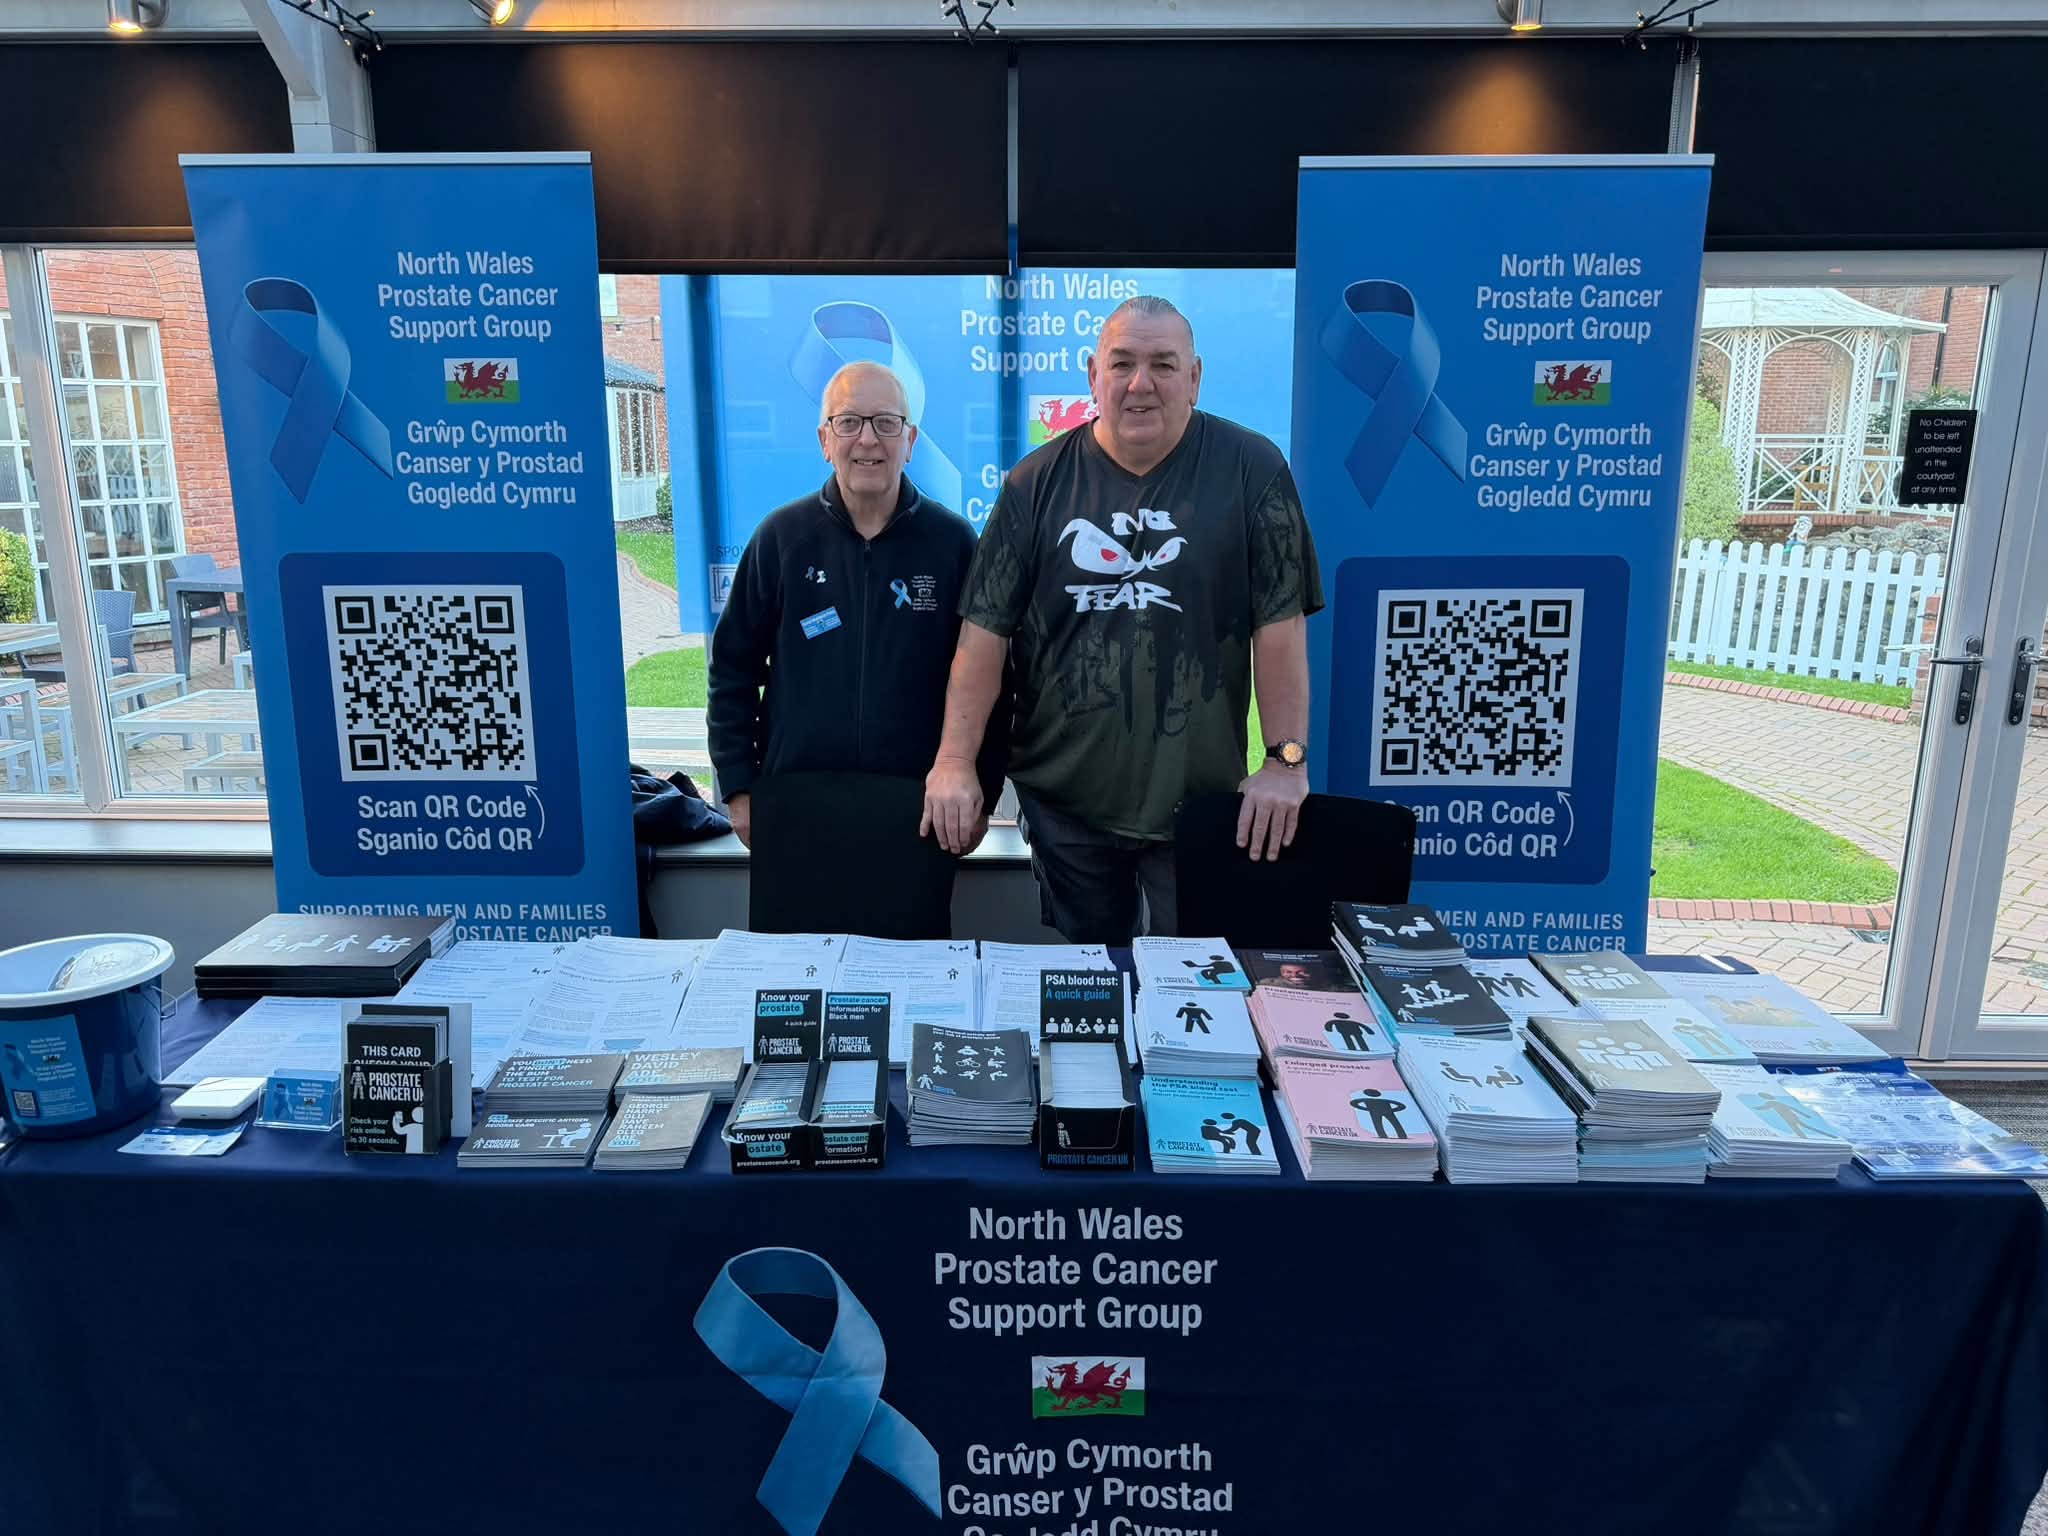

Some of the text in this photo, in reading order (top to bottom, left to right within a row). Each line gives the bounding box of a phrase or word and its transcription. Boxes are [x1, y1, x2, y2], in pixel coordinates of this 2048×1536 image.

[397, 251, 534, 275] North Wales
[1500, 252, 1642, 277] North Wales
[985, 272, 1139, 300] North Wales
[378, 283, 558, 308] Prostate Cancer
[1476, 284, 1663, 309] Prostate Cancer
[389, 315, 552, 343] Support Group
[961, 309, 1066, 336] Prostate
[1483, 317, 1651, 346] Support Group
[970, 345, 1069, 377] Support
[1919, 418, 1968, 427] No Children
[407, 419, 568, 449] Grŵp Cymorth
[1486, 421, 1652, 451] Grŵp Cymorth
[1923, 432, 1932, 440] to
[1933, 432, 1945, 440] be
[1914, 446, 1963, 454] unattended
[396, 450, 584, 479] Canser y Prostad
[1470, 453, 1663, 482] Canser y Prostad
[1934, 459, 1948, 467] the
[1916, 472, 1956, 481] courtyard
[407, 482, 576, 510] Gogledd Cymru
[1477, 485, 1652, 513] Gogledd Cymru
[1911, 486, 1920, 494] at
[1921, 486, 1937, 495] any
[1064, 581, 1184, 613] FEAR
[357, 795, 527, 820] Scan QR Code
[1447, 800, 1484, 825] QR
[1491, 800, 1556, 825] Code
[356, 825, 533, 856] Sganio Côd QR
[1464, 832, 1513, 857] Côd
[1520, 834, 1558, 859] QR
[426, 904, 467, 921] MEN
[474, 904, 513, 920] AND
[519, 903, 608, 921] FAMILIES
[1436, 910, 1624, 931] MEN AND FAMILIES
[455, 926, 613, 943] OSTATE CANCER
[1451, 933, 1627, 952] OSTATE CANCER
[1045, 974, 1119, 986] PSA blood test:
[760, 993, 811, 1003] Know your
[1045, 988, 1111, 1001] A quick guide
[760, 1004, 800, 1014] prostate
[769, 1038, 800, 1047] PROSTATE
[838, 1044, 872, 1053] CANCER UK
[839, 1036, 869, 1045] PROSTATE
[361, 1045, 422, 1057] THIS CARD
[635, 1052, 702, 1062] WESLEY
[769, 1046, 803, 1055] CANCER UK
[631, 1062, 680, 1070] DAVID
[368, 1072, 422, 1087] PROSTATE
[1151, 1077, 1219, 1087] Understanding
[369, 1086, 411, 1101] CANCER
[350, 1117, 371, 1125] Check
[358, 1136, 367, 1144] 30
[736, 1132, 792, 1143] Know your
[748, 1143, 782, 1153] ostate
[1047, 1153, 1087, 1165] PROSTATE
[969, 1207, 1183, 1240] North Wales
[935, 1252, 1218, 1285] Prostate Cancer
[949, 1297, 1203, 1336] Support Group
[966, 1438, 1212, 1479] Grŵp Cymorth
[947, 1477, 1233, 1518] Canser y Prostad
